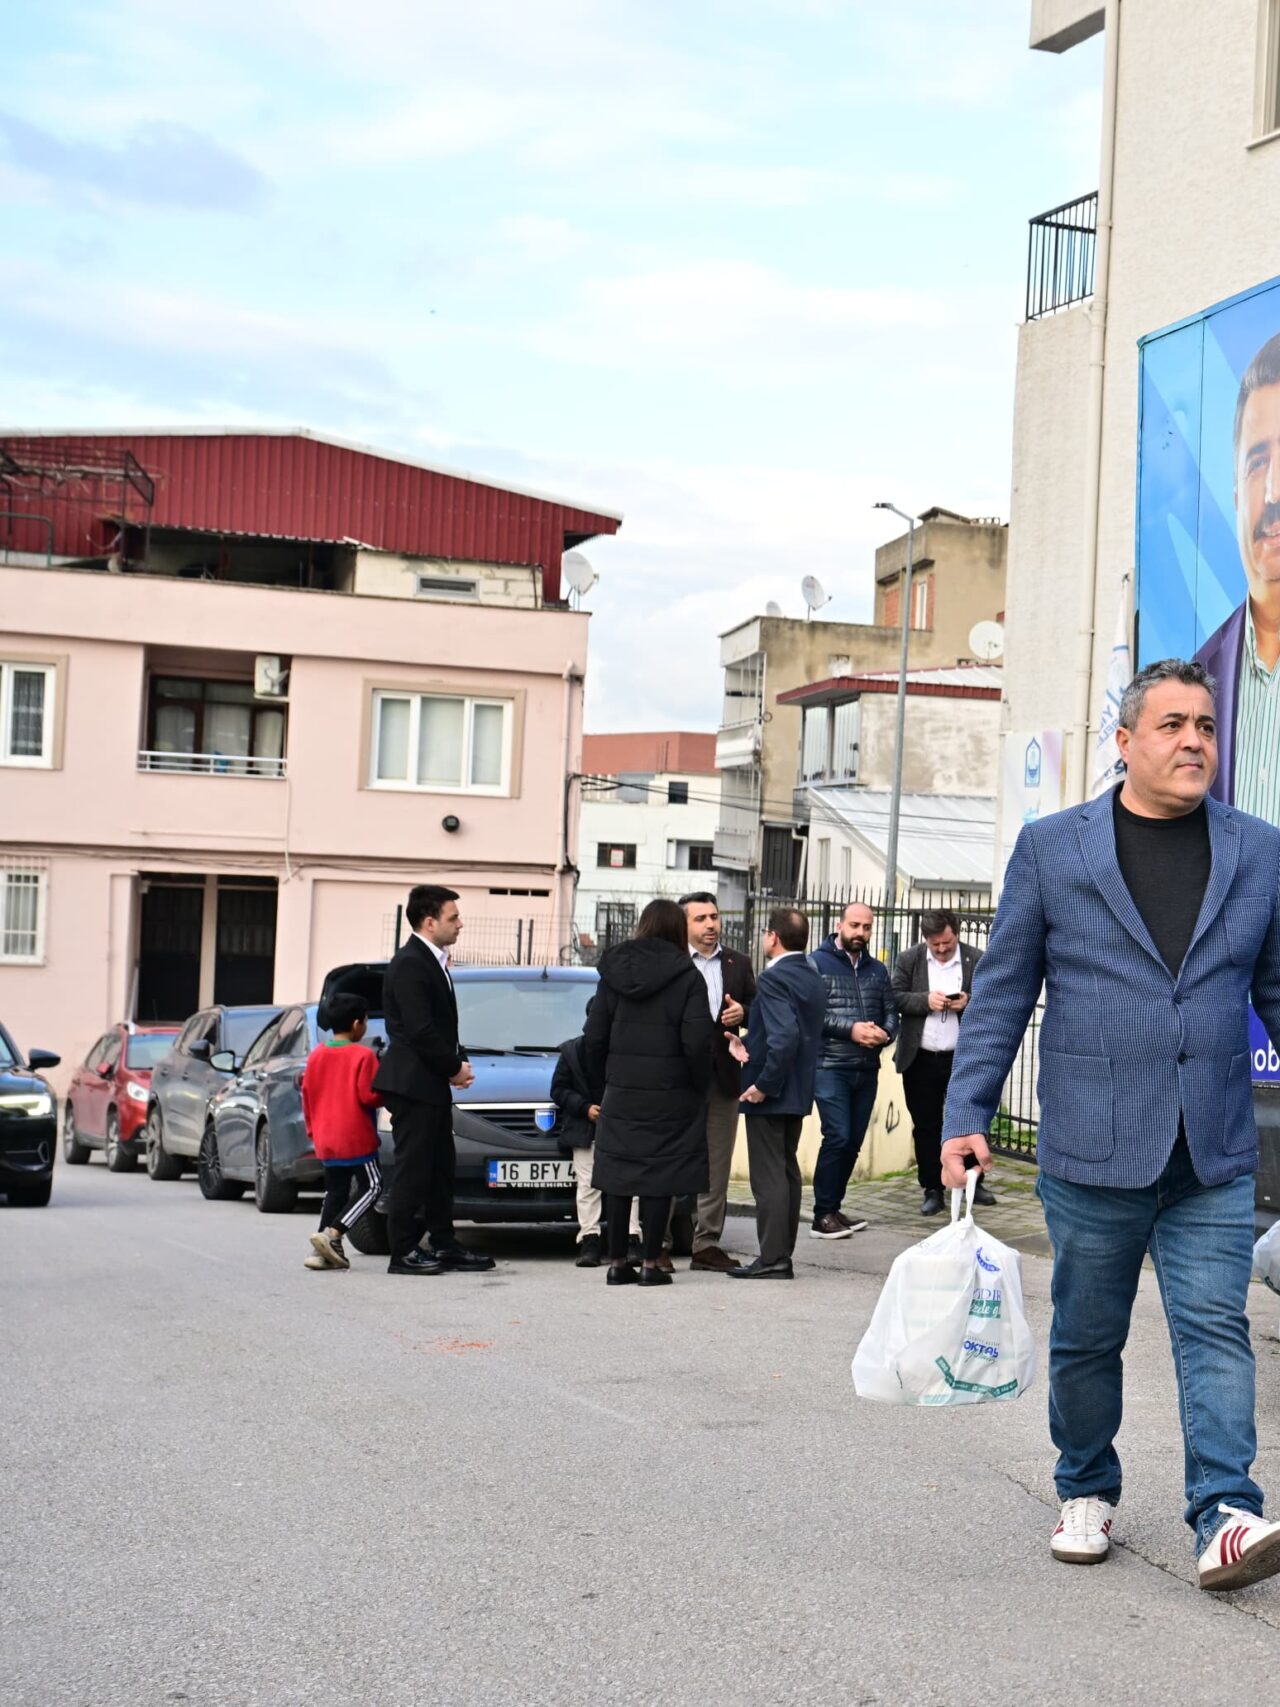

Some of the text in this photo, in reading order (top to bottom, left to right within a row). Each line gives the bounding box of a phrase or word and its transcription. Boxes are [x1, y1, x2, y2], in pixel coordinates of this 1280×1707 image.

[501, 1163, 519, 1180] 16
[530, 1163, 560, 1180] BFY
[963, 1340, 999, 1358] OKTAY
